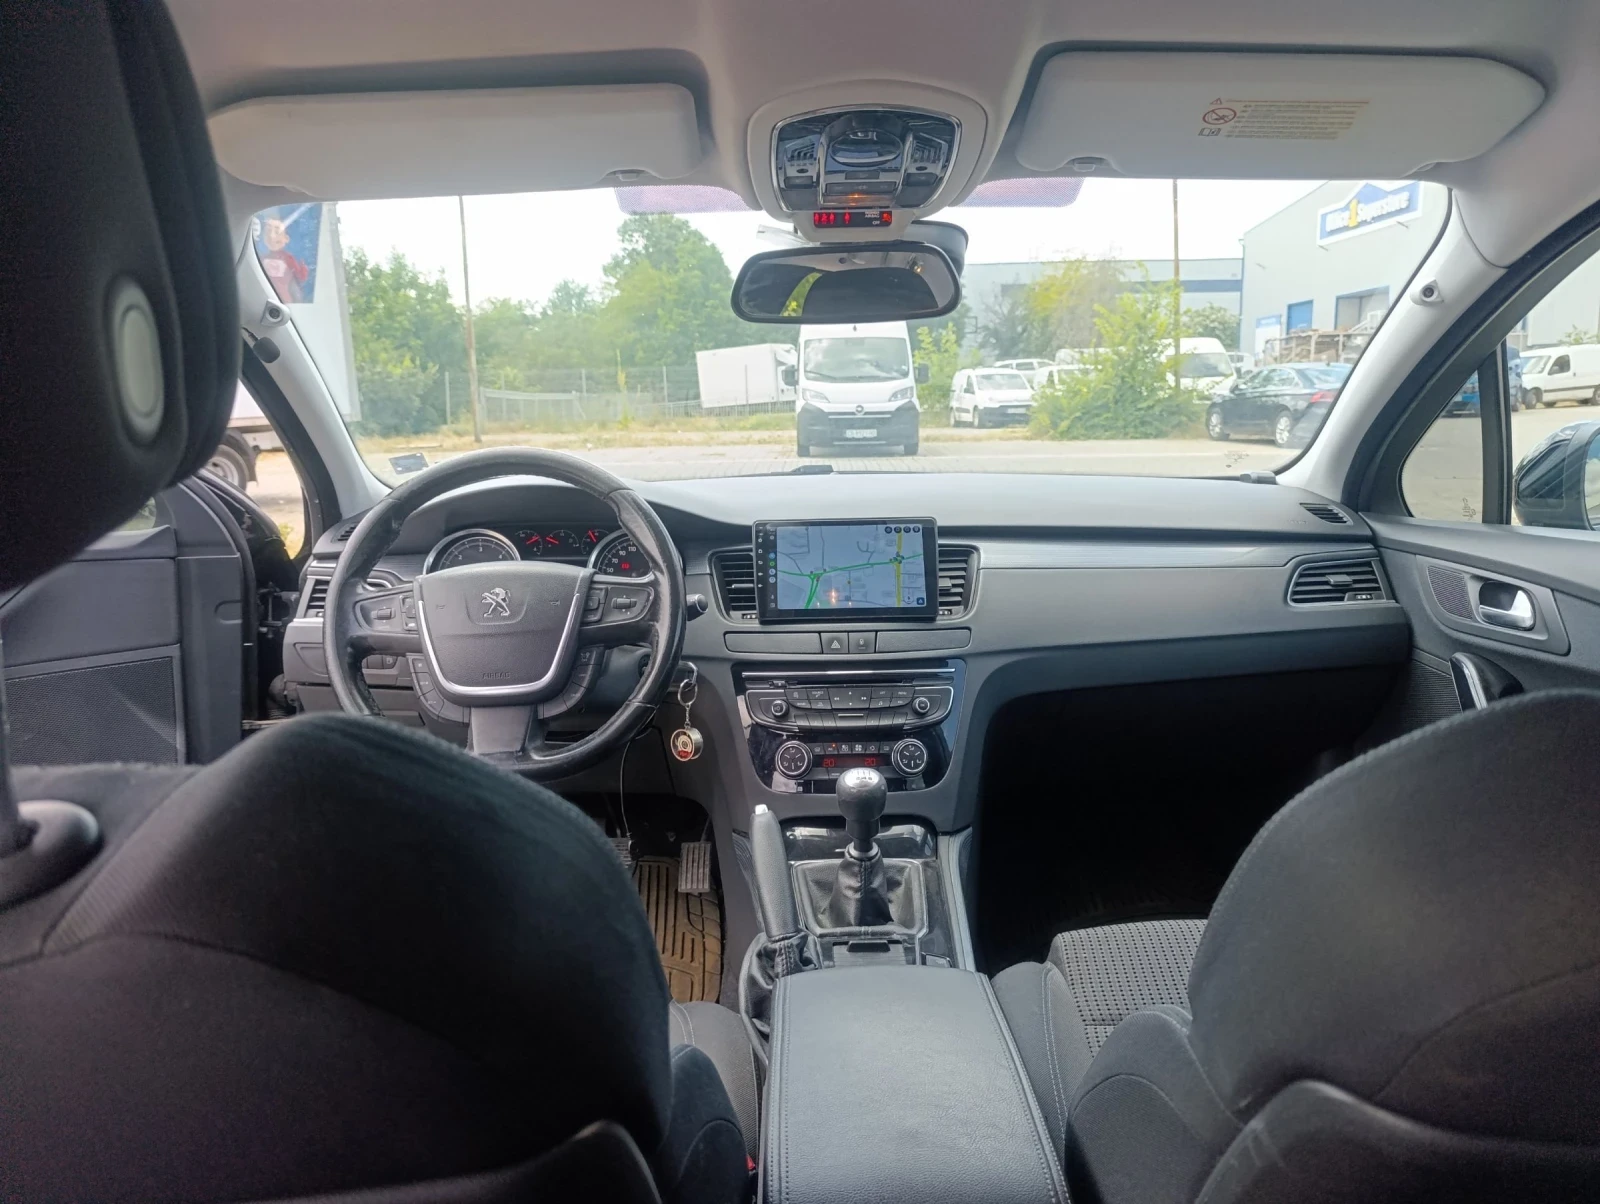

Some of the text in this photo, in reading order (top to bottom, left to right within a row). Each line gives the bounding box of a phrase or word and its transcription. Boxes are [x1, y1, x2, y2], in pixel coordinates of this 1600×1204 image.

[1348, 198, 1359, 228] 1
[823, 757, 876, 767] 20 20
